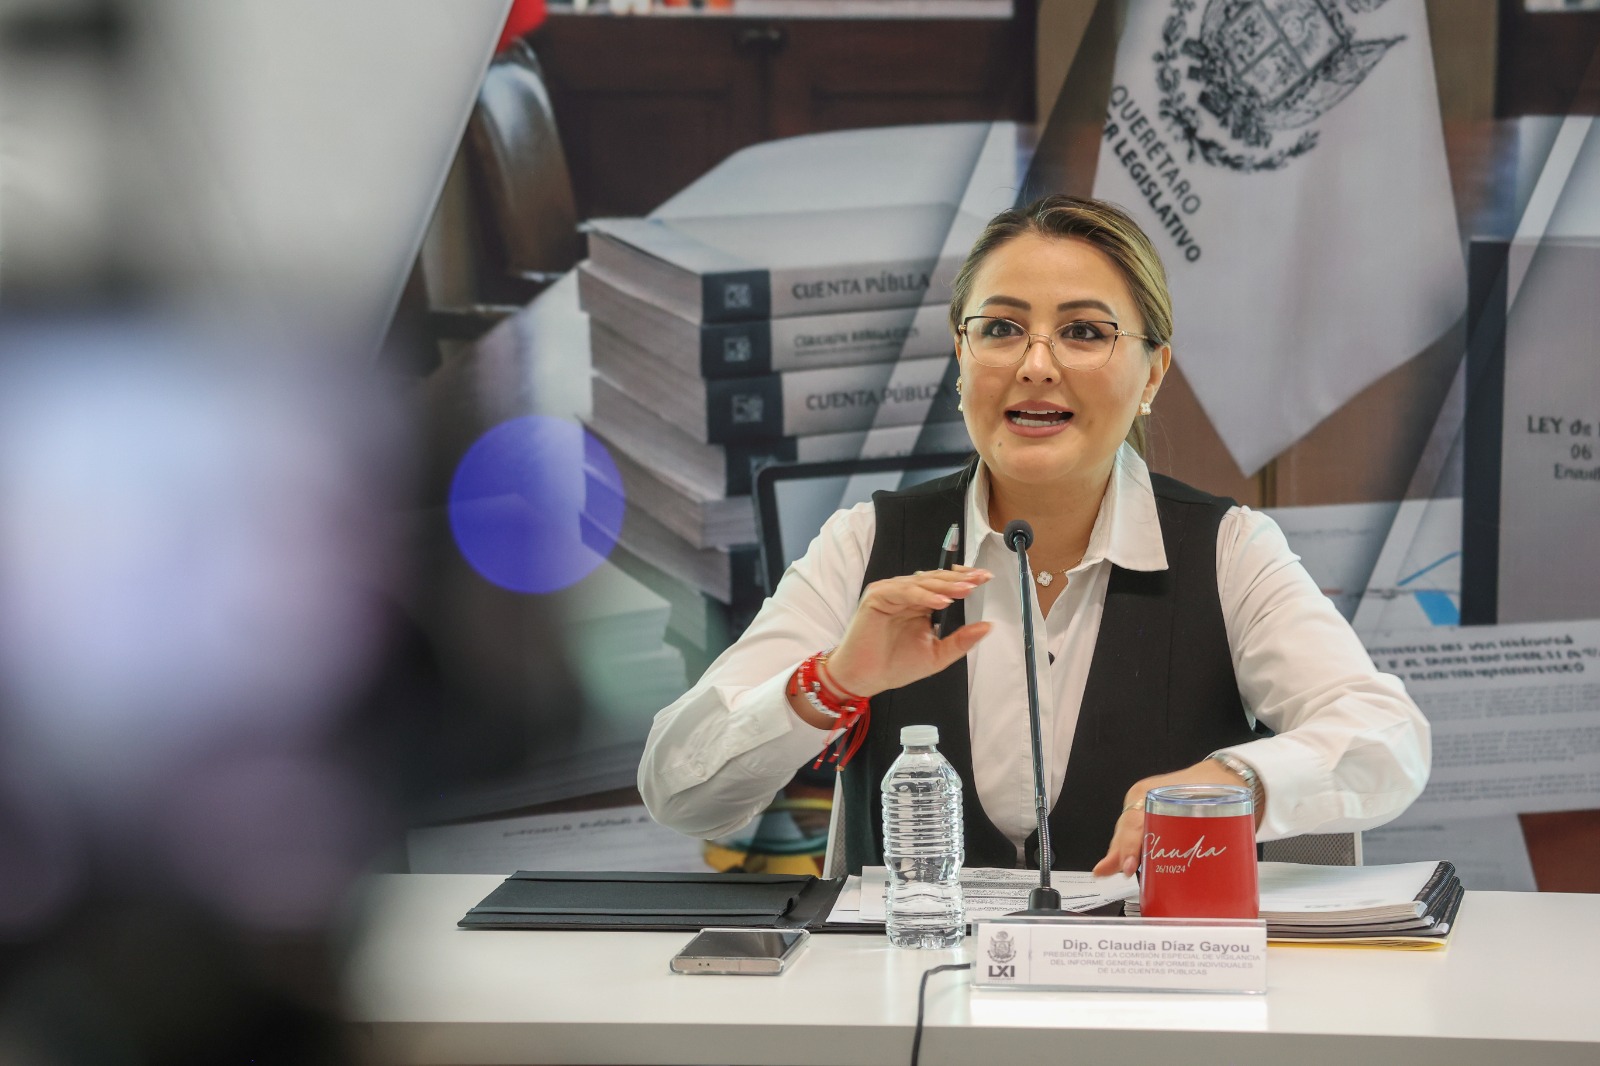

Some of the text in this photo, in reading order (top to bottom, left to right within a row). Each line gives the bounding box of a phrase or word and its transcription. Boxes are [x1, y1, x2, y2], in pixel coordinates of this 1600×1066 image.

[1114, 139, 1201, 263] LEGISLATIVO
[792, 278, 862, 300] CUENTA
[806, 388, 879, 410] CUENTA
[1527, 414, 1563, 434] LEY
[1143, 832, 1227, 867] Claudia
[1155, 865, 1187, 874] 26/10/24
[1062, 939, 1092, 952] Dip.
[1098, 939, 1156, 951] Claudia
[1199, 941, 1250, 954] Gayou
[1107, 951, 1118, 959] LA
[1161, 952, 1200, 960] ESPECIAL
[1202, 953, 1213, 961] DE
[988, 965, 1015, 978] LXI
[1127, 967, 1166, 975] CUENTAS
